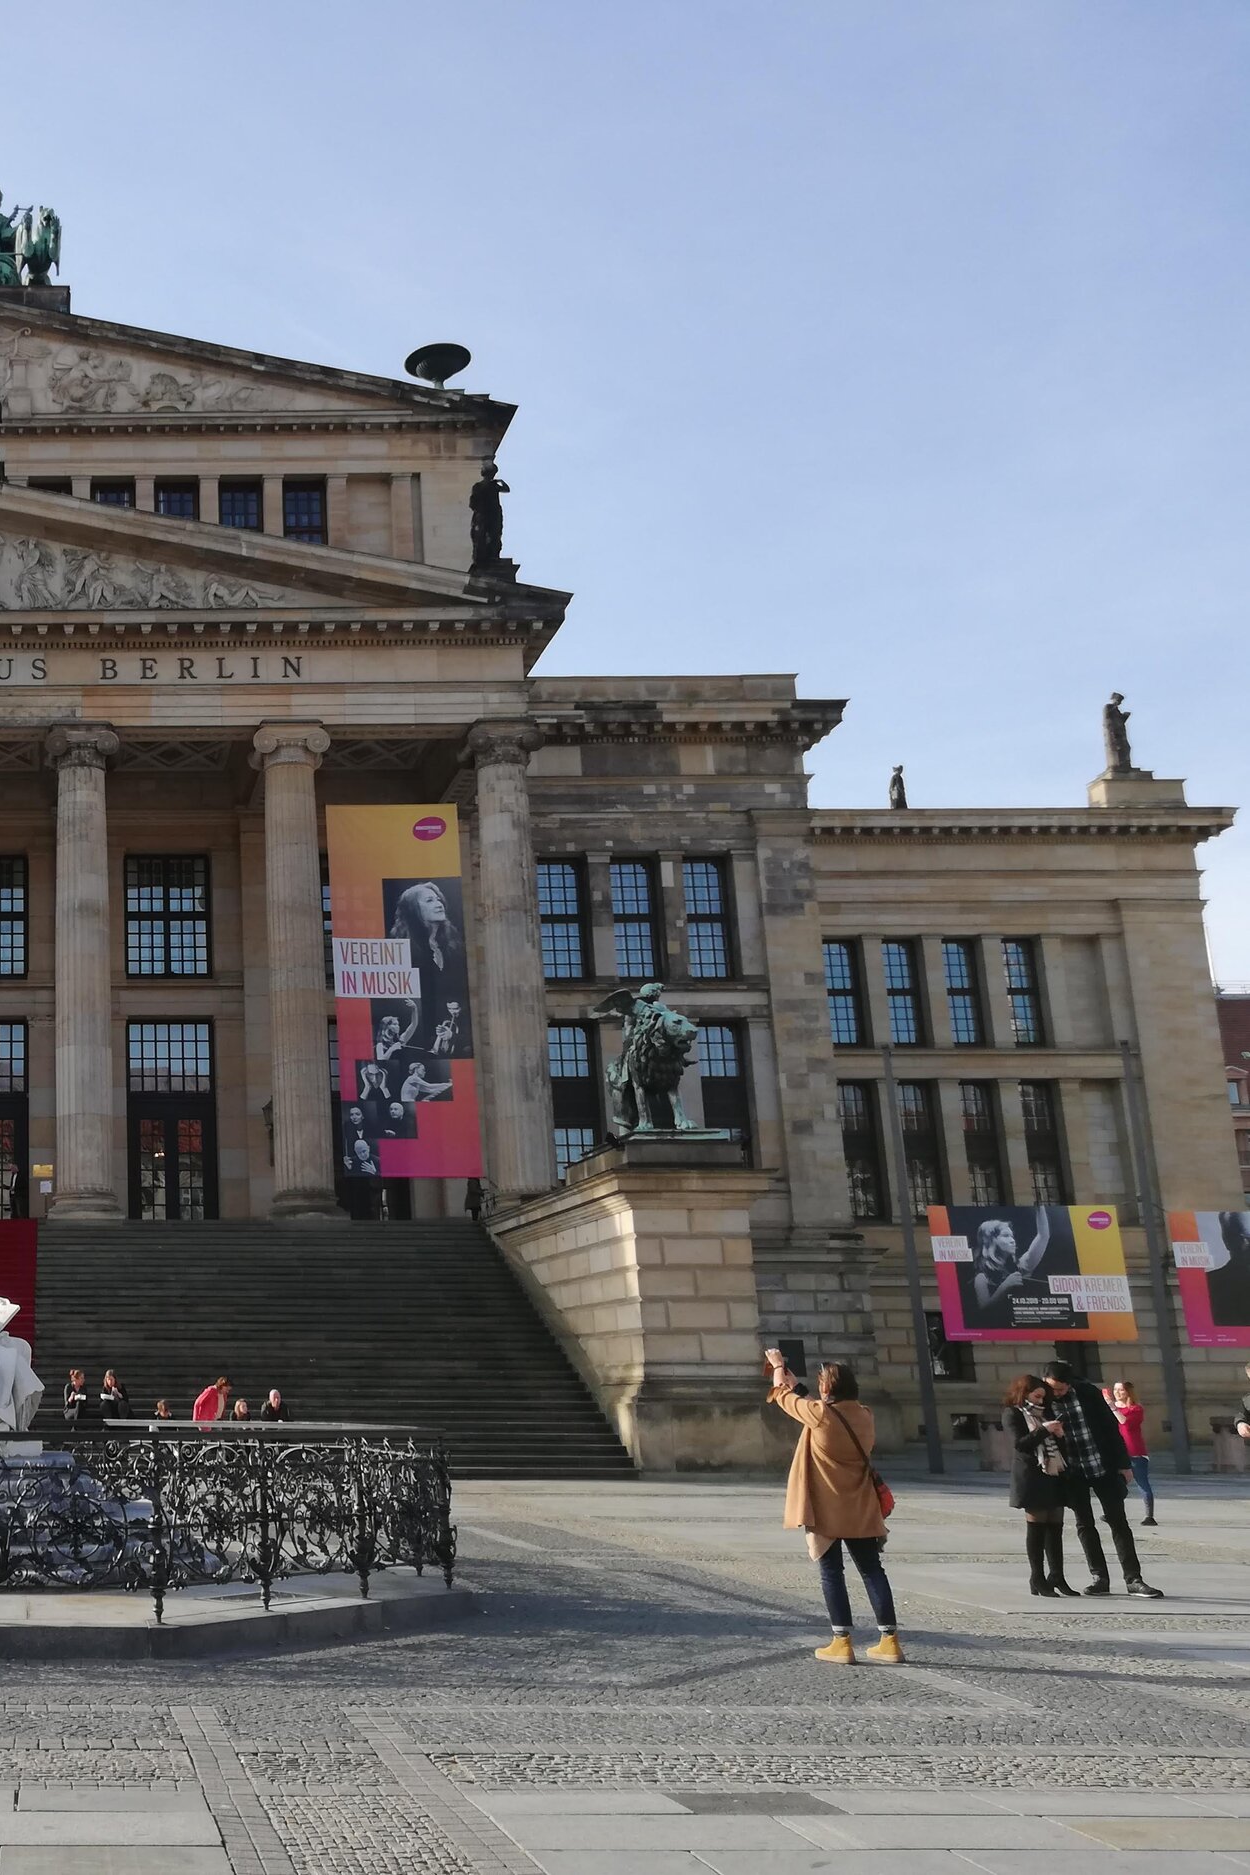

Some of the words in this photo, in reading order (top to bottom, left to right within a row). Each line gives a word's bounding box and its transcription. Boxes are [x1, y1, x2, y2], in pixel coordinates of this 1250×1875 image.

[100, 656, 303, 680] BERLIN
[339, 941, 404, 966] VEREINT
[341, 970, 358, 995] IN
[361, 971, 414, 995] MUSIK
[1052, 1277, 1082, 1292] GIDON
[1083, 1277, 1124, 1292] KREMER
[1076, 1295, 1085, 1311] &
[1086, 1295, 1127, 1311] FRIENDS
